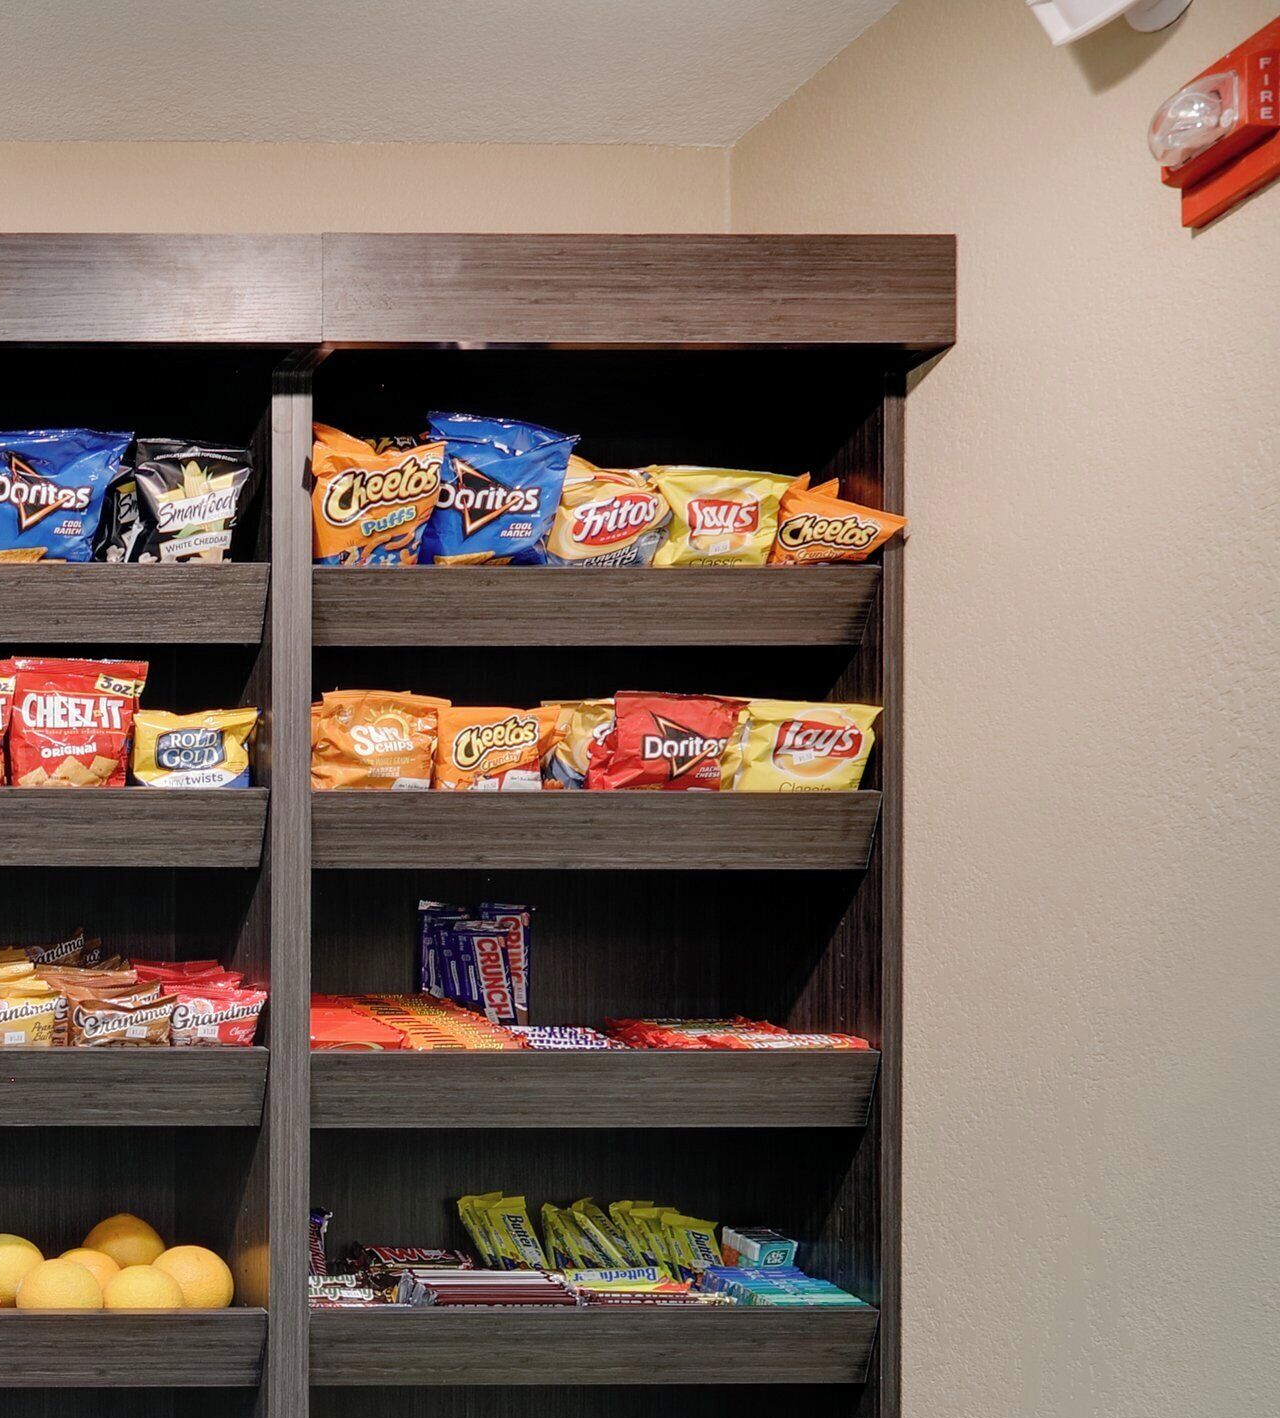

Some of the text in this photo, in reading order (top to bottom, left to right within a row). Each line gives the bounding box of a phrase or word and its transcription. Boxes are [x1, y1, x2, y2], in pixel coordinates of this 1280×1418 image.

[1259, 57, 1273, 119] FIRE
[325, 459, 441, 524] Cheetos
[436, 484, 540, 510] Doritos
[157, 489, 237, 529] Smartfood
[362, 506, 416, 536] Puffs
[573, 496, 659, 543] Fritos
[693, 501, 758, 536] Lay's
[54, 527, 82, 535] RANCH
[509, 522, 533, 530] COOL
[779, 513, 880, 549] Cheetos
[796, 550, 840, 560] Crunchy
[22, 693, 124, 729] CHEEZ-IT
[170, 730, 217, 748] ROLD
[377, 741, 413, 752] CHIPS
[453, 715, 538, 769] Cheetos
[644, 735, 727, 760] Doritos
[163, 747, 218, 768] GOLD
[481, 751, 523, 772] Crunchy
[185, 773, 223, 785] twists
[477, 938, 510, 1019] CRUNCH
[769, 1250, 786, 1259] tic
